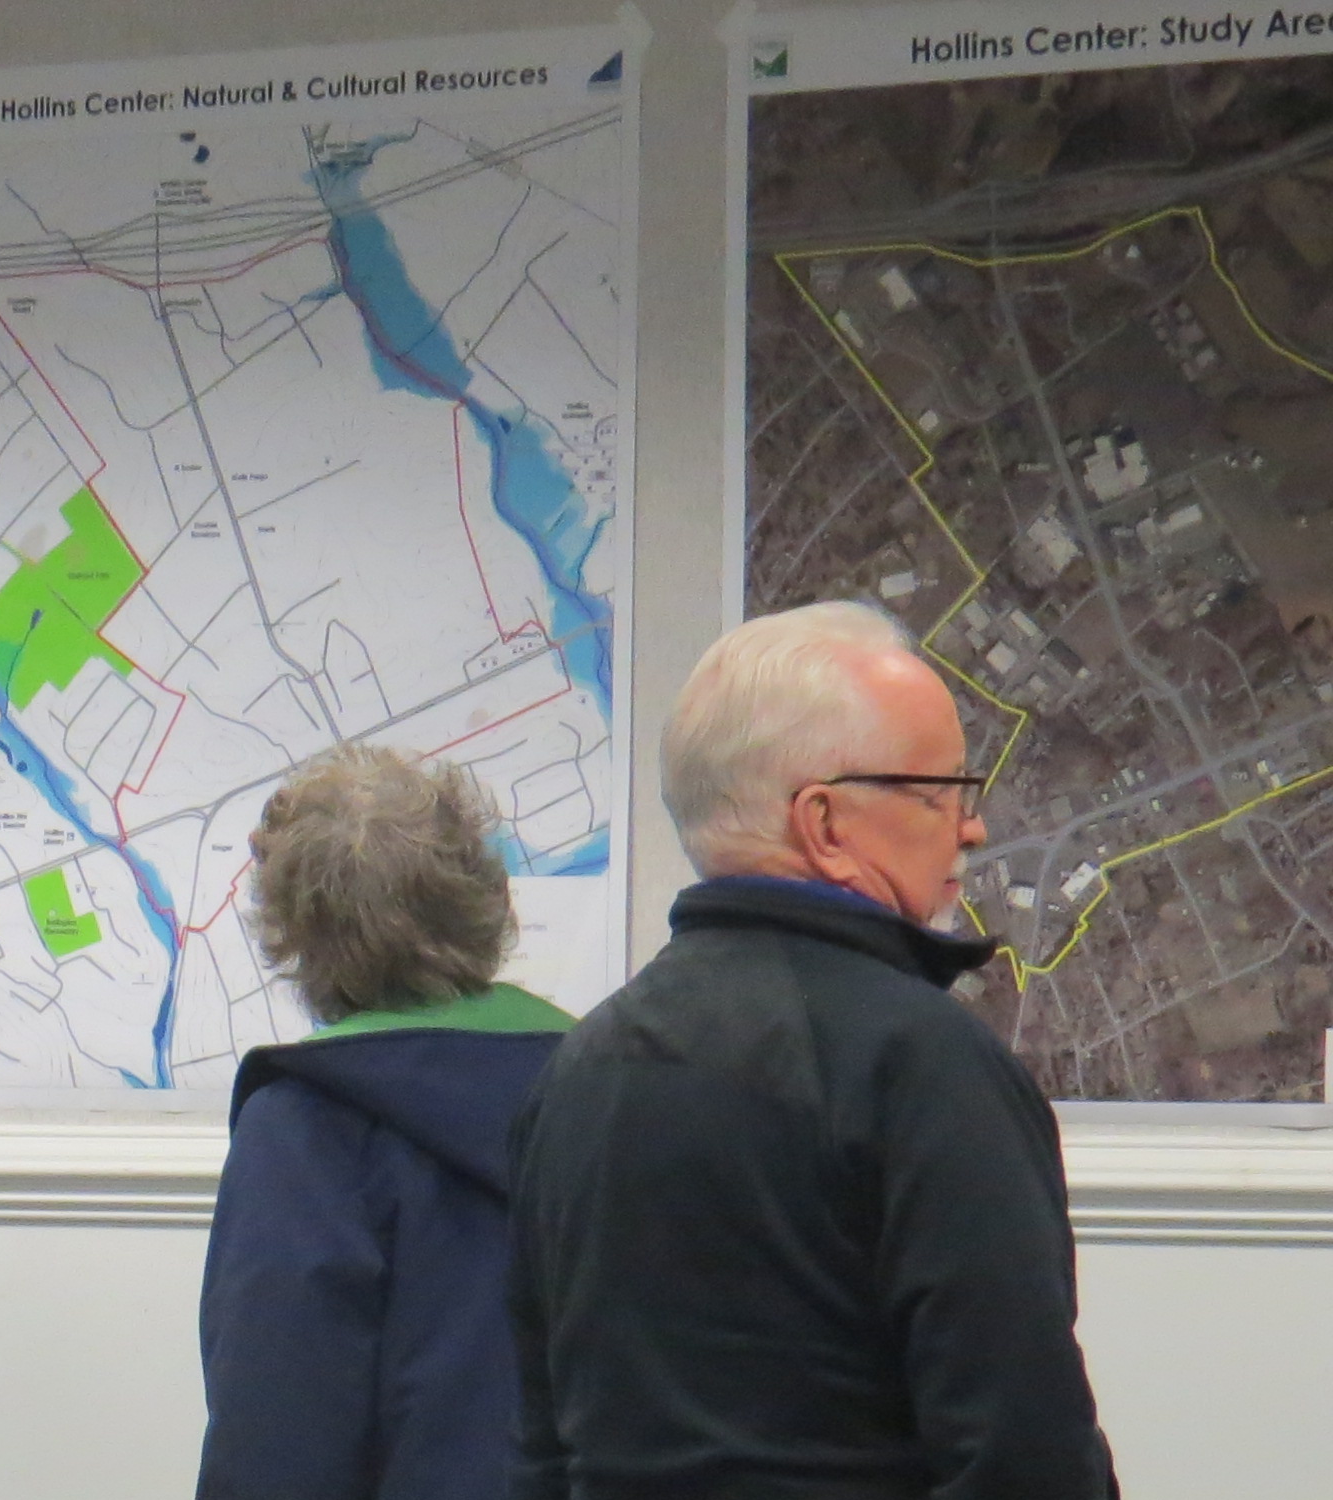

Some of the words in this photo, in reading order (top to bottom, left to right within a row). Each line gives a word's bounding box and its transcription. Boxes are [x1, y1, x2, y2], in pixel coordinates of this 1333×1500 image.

[910, 32, 1014, 64] Hollins
[1025, 23, 1148, 56] Center:
[1160, 12, 1254, 48] Study
[0, 96, 77, 123] Hollins
[84, 89, 175, 117] Center:
[183, 80, 274, 108] Natural
[281, 80, 298, 102] &
[307, 71, 407, 100] Cultural
[415, 65, 549, 93] Resources
